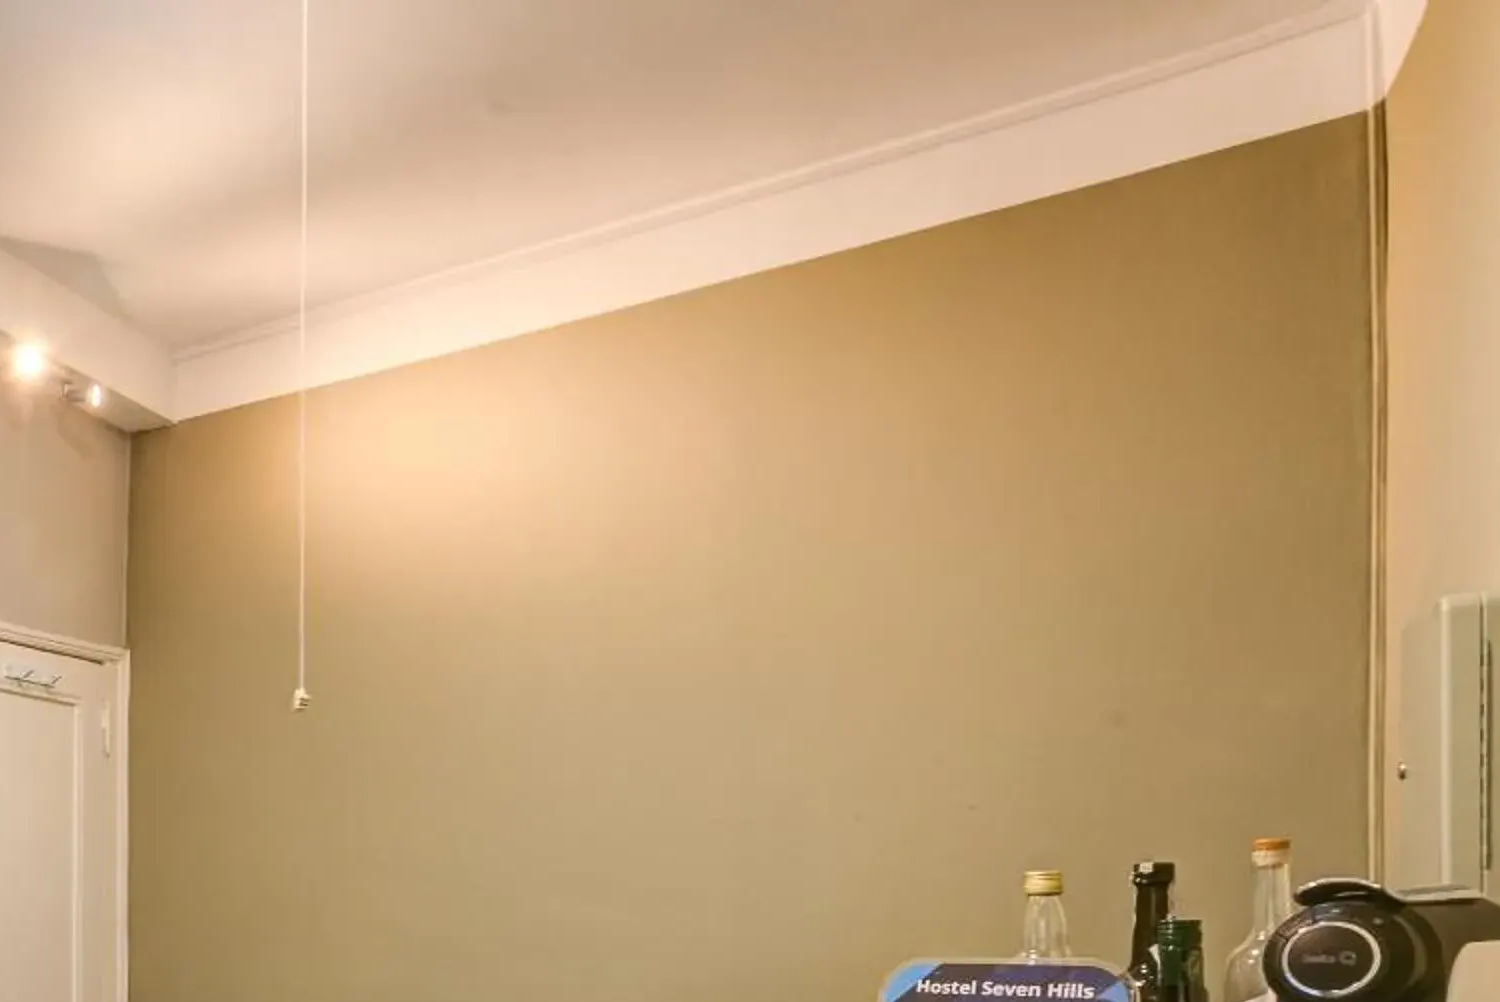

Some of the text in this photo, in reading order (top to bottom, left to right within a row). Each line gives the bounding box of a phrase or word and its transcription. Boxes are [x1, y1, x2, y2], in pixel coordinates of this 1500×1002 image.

[916, 979, 1096, 1000] Hostel Seven Hills
